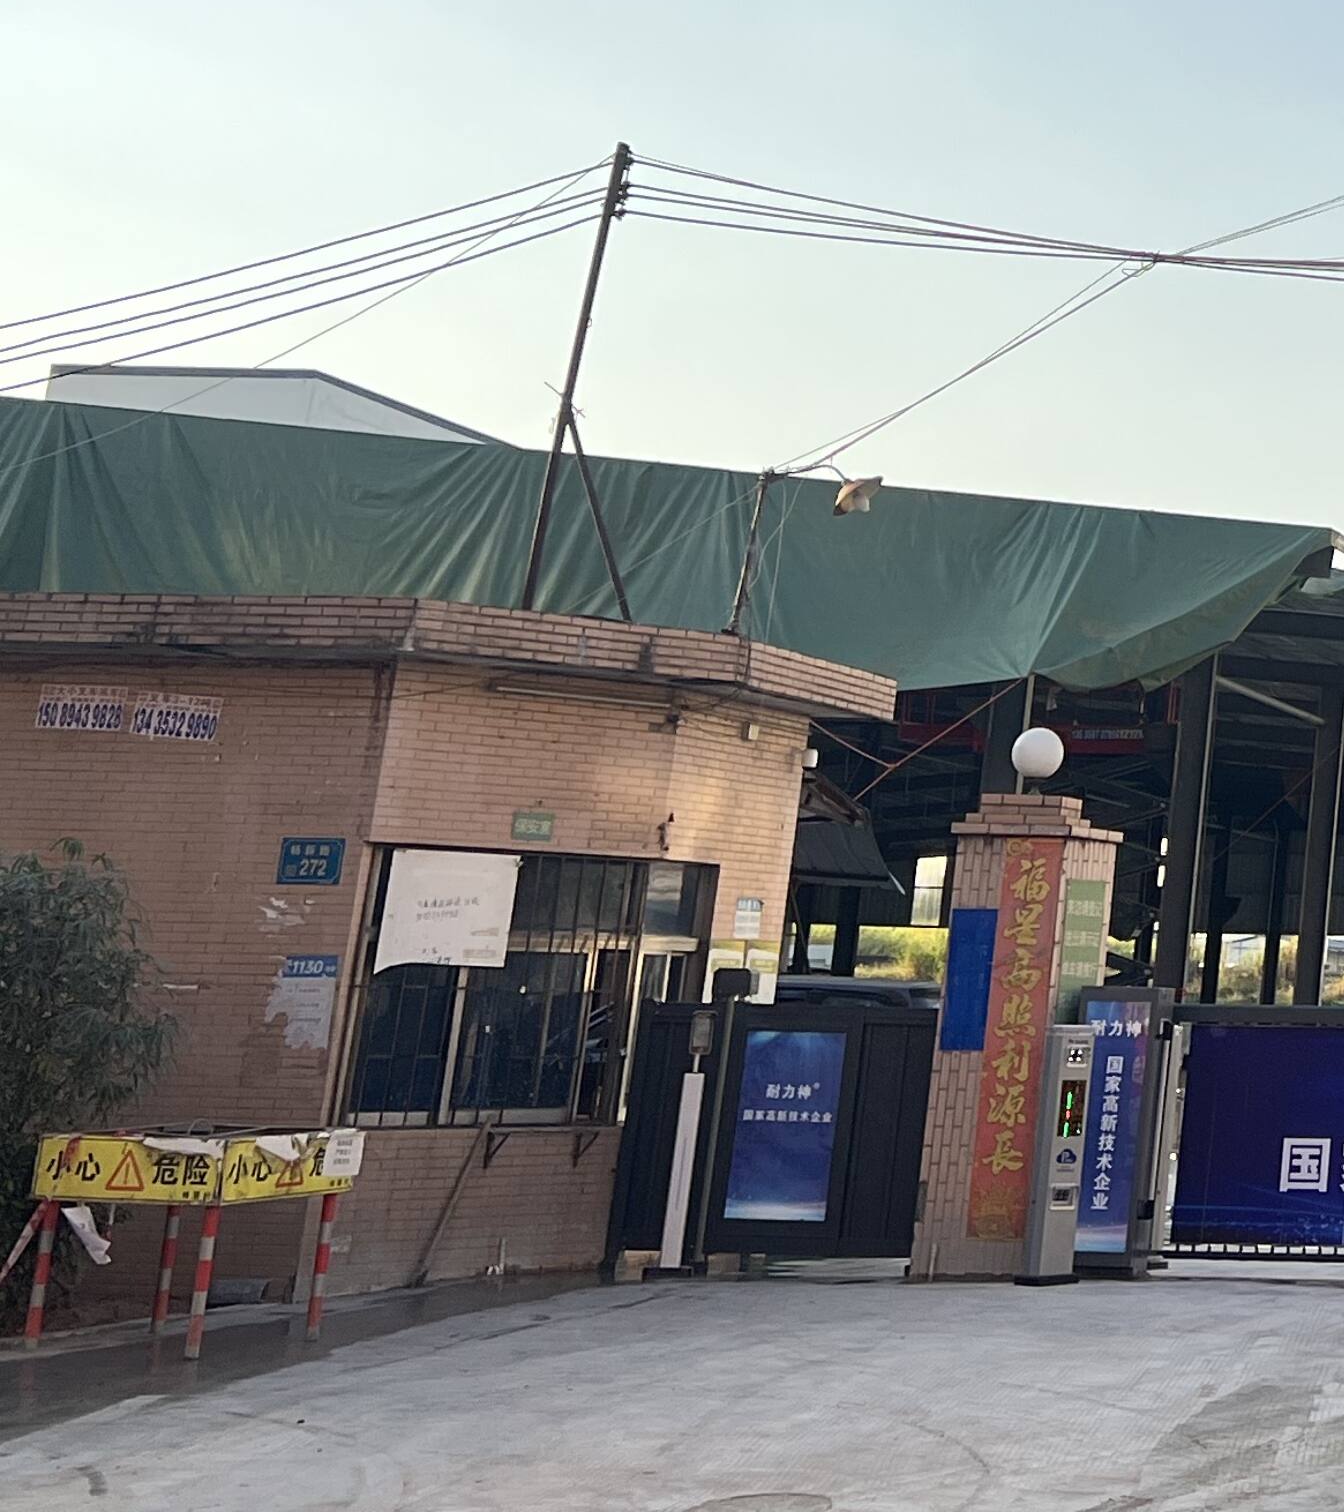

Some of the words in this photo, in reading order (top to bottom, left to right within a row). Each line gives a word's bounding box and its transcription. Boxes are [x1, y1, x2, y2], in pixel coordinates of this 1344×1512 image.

[299, 859, 327, 876] 272
[1090, 1055, 1124, 1211] 国家高新技术企业
[152, 1155, 210, 1186] 危险
